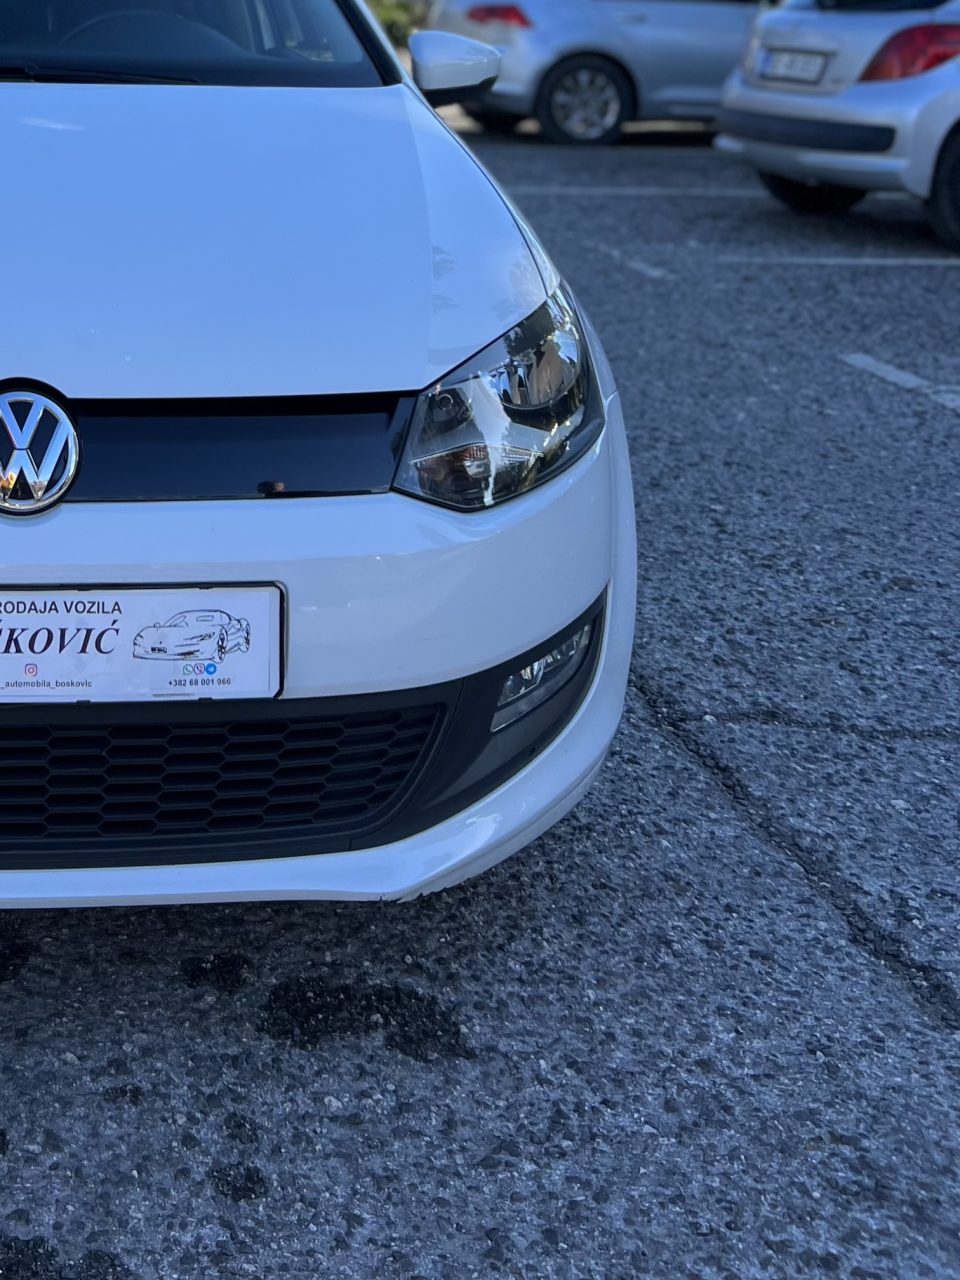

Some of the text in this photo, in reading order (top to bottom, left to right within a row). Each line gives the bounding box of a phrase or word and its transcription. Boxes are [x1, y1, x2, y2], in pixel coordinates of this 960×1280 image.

[63, 600, 123, 614] VOZILA
[168, 678, 187, 687] +382
[189, 678, 199, 687] 68
[201, 678, 215, 686] 001
